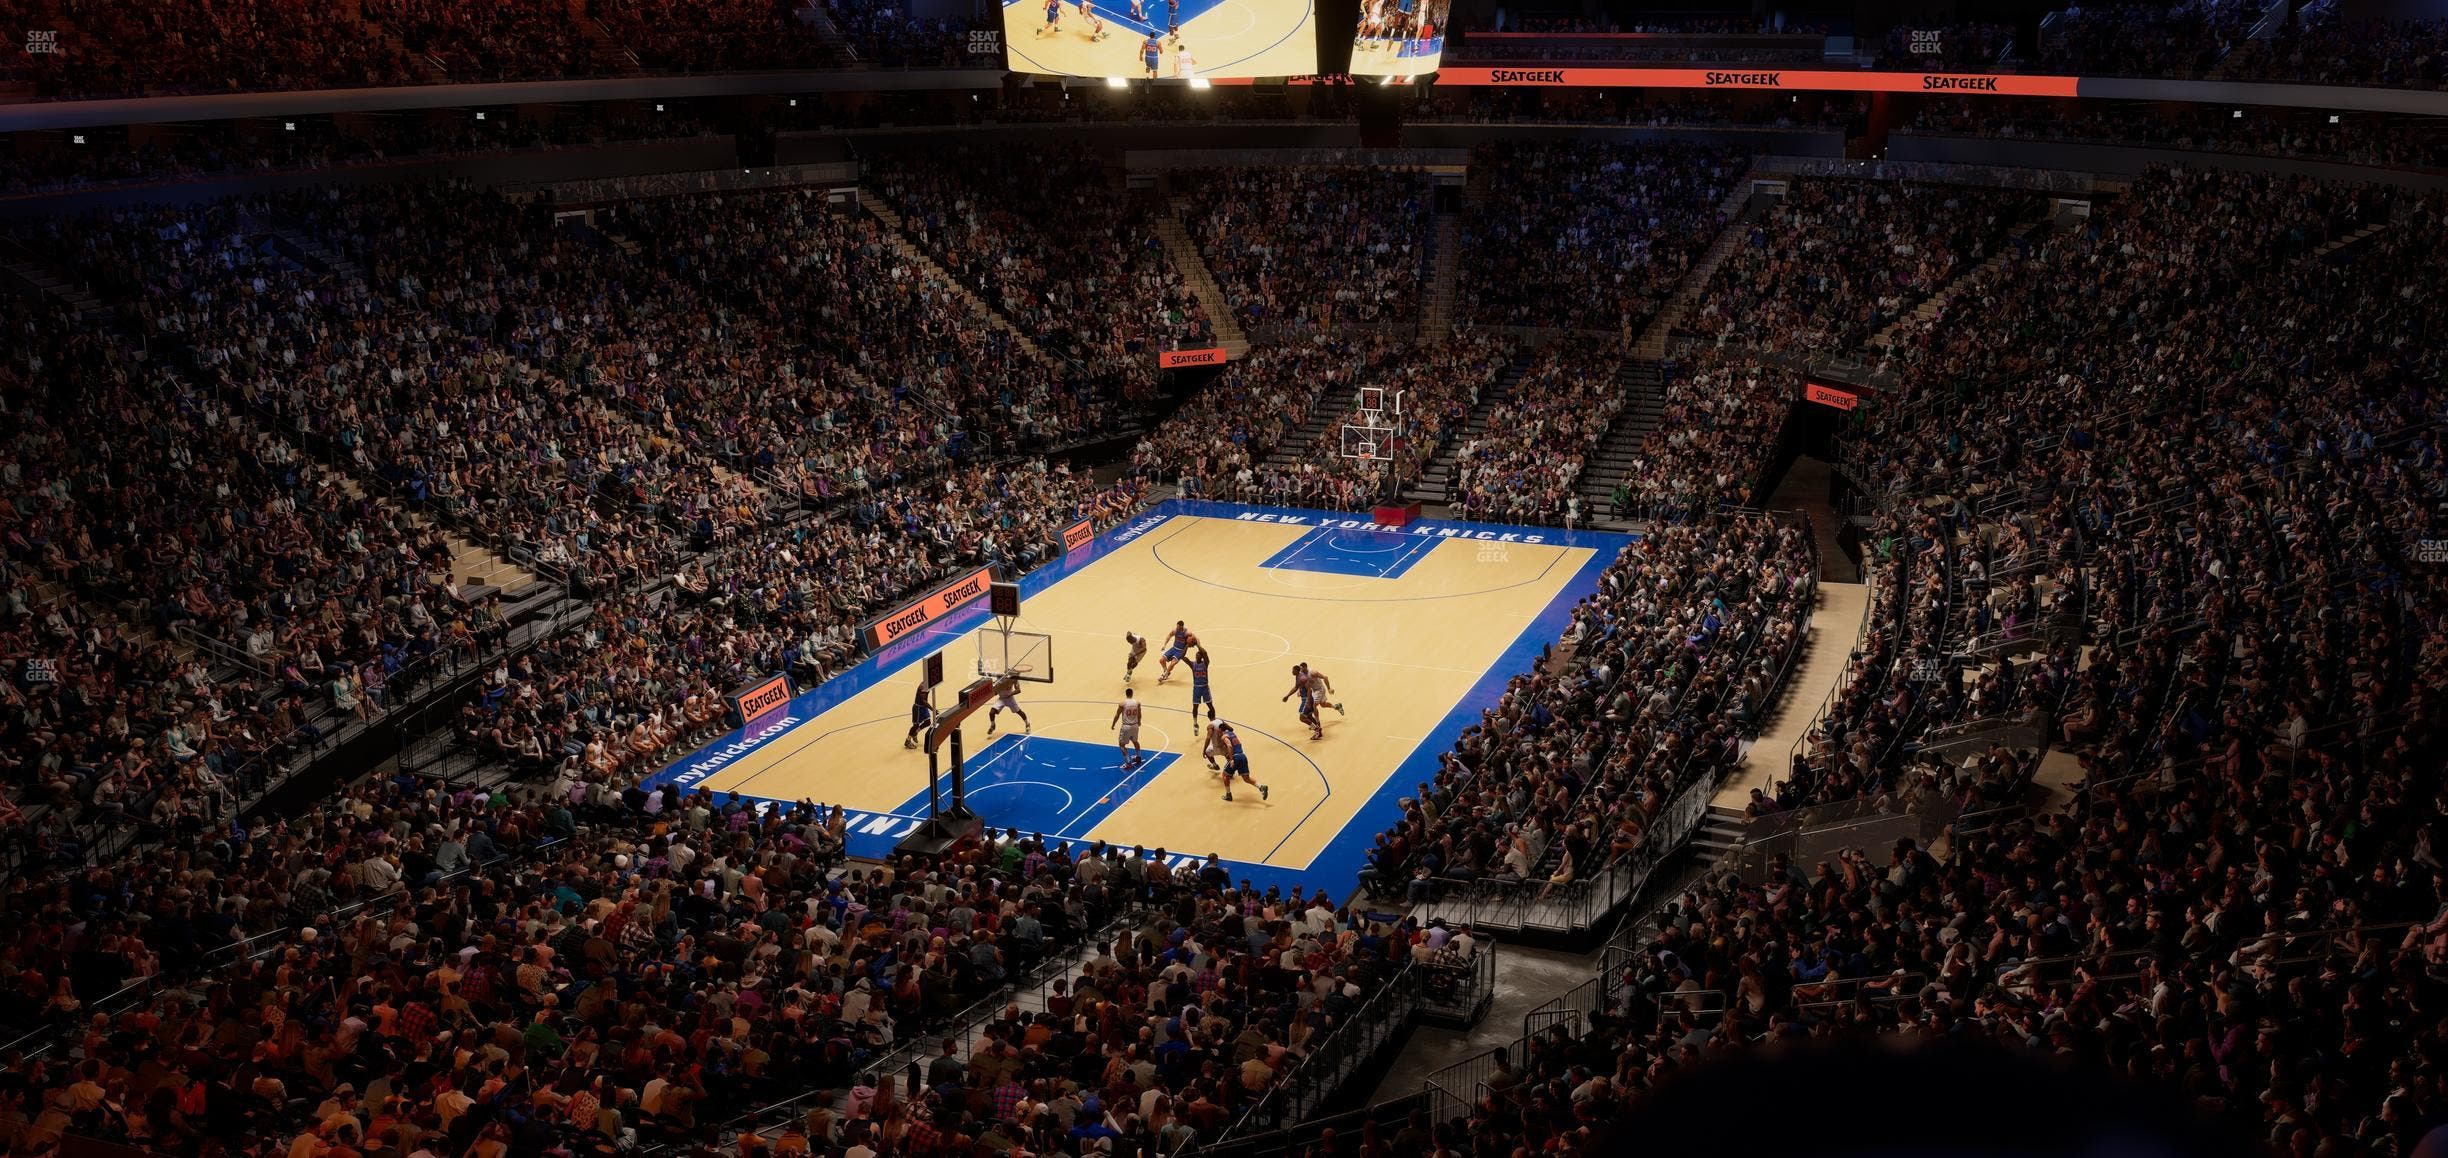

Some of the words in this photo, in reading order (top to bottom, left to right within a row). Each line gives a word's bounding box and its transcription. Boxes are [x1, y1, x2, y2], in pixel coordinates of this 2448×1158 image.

[1491, 70, 1564, 83] SEATGEEK
[1706, 72, 1780, 86] SEATGEEK
[1923, 75, 1998, 91] SEATGEEK
[1170, 352, 1214, 365] SEATGEEK
[1815, 390, 1849, 407] SEATGEEK
[1065, 524, 1092, 547] SEATGEEK
[1235, 512, 1308, 524] NEW
[1319, 518, 1401, 532] YORK
[1413, 526, 1544, 544] KNICKS
[886, 605, 928, 639] SEATGEEK
[943, 577, 982, 609] SEATGEEK
[743, 682, 787, 717] SEATGEEK
[673, 716, 800, 784] nyknicks.com
